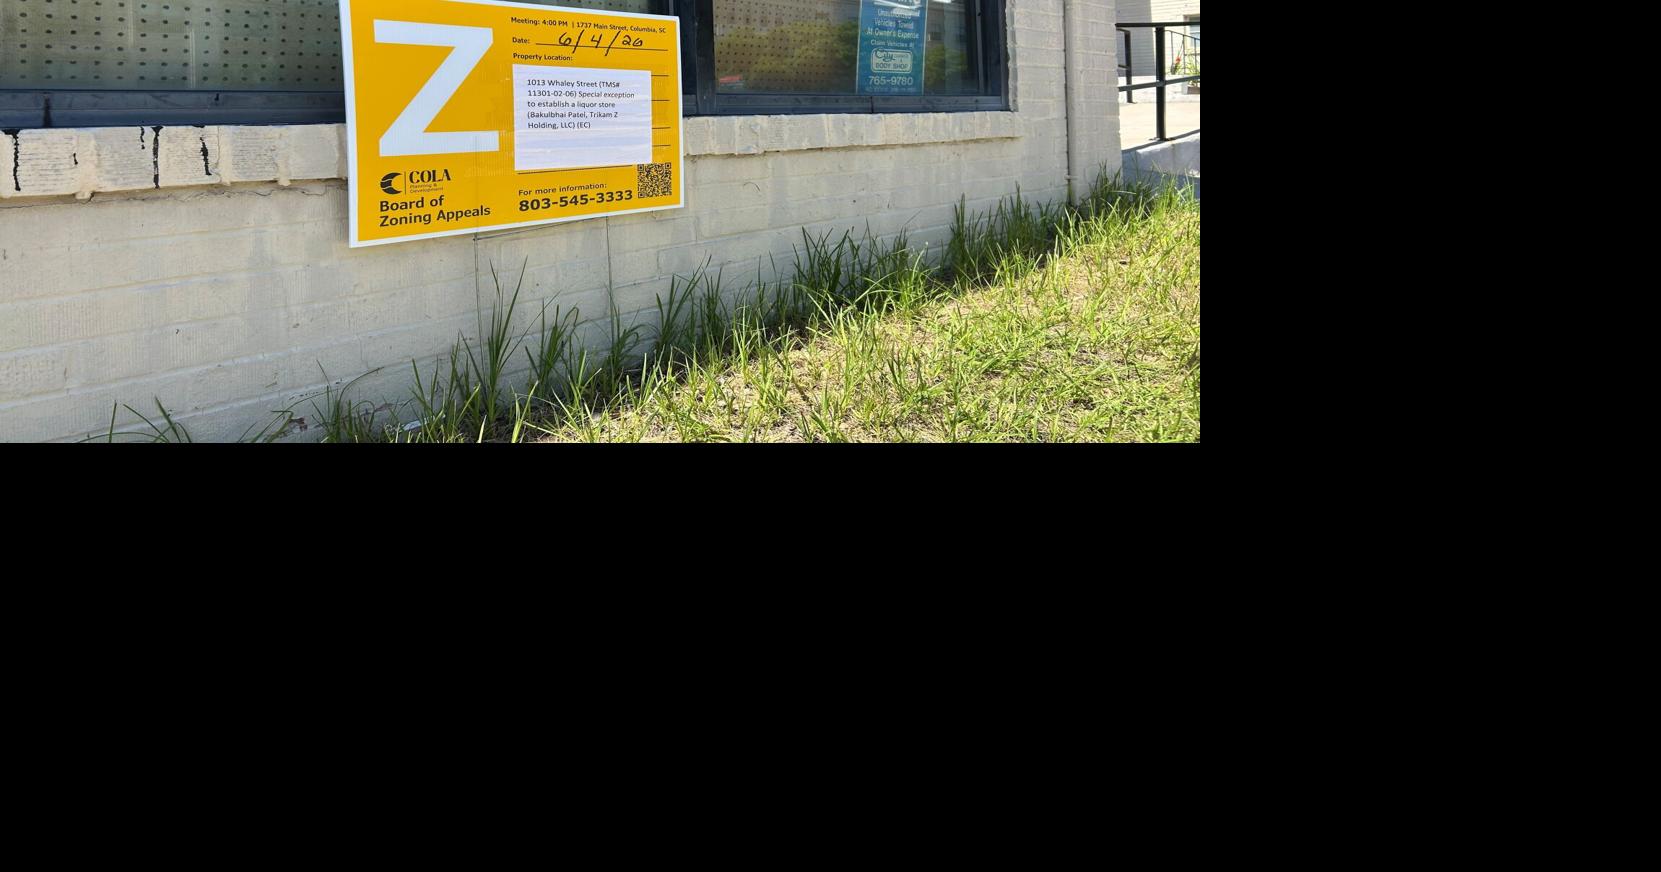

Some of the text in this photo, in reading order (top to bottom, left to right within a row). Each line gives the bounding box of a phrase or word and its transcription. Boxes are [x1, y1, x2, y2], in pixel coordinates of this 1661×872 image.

[511, 17, 540, 26] Meeting:
[630, 25, 658, 33] Columbia,
[513, 53, 542, 61] Property
[547, 80, 575, 88] Whaley
[576, 80, 598, 88] Street
[868, 75, 914, 86] 765-9780
[373, 19, 500, 157] Z
[528, 90, 577, 98] 11301-02-06)
[578, 91, 603, 99] Special
[527, 111, 567, 119] (Bakulbhai
[528, 121, 591, 130] Holding, LLC) (EC)
[409, 168, 451, 184] COLA
[534, 187, 557, 195] more
[559, 182, 607, 192] information:
[379, 194, 445, 212] Board of
[518, 189, 633, 212] 803-545-3333
[379, 204, 491, 227] Zoning Appeals
